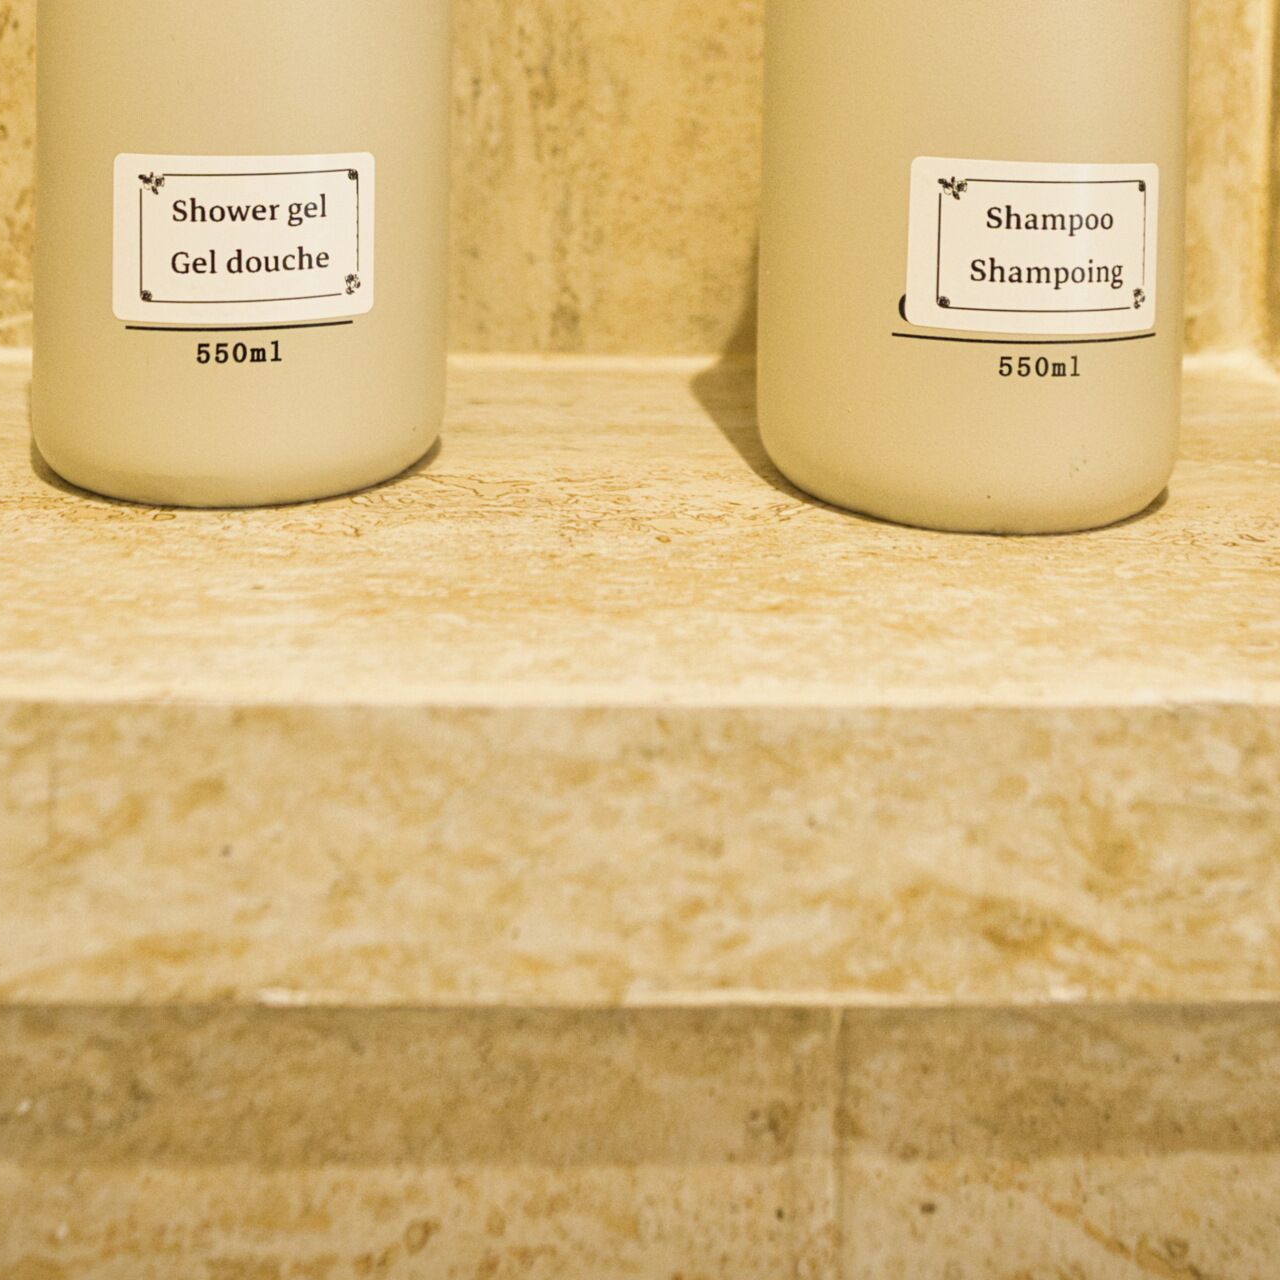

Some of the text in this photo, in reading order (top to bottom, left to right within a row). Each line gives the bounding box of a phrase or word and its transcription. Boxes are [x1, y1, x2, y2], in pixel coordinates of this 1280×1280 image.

[172, 194, 327, 227] Shower gel
[986, 205, 1114, 236] Shampoo
[171, 246, 330, 274] Gel douche
[970, 257, 1124, 290] Shampoing
[196, 340, 283, 363] 550ml
[998, 355, 1081, 377] 550ml
